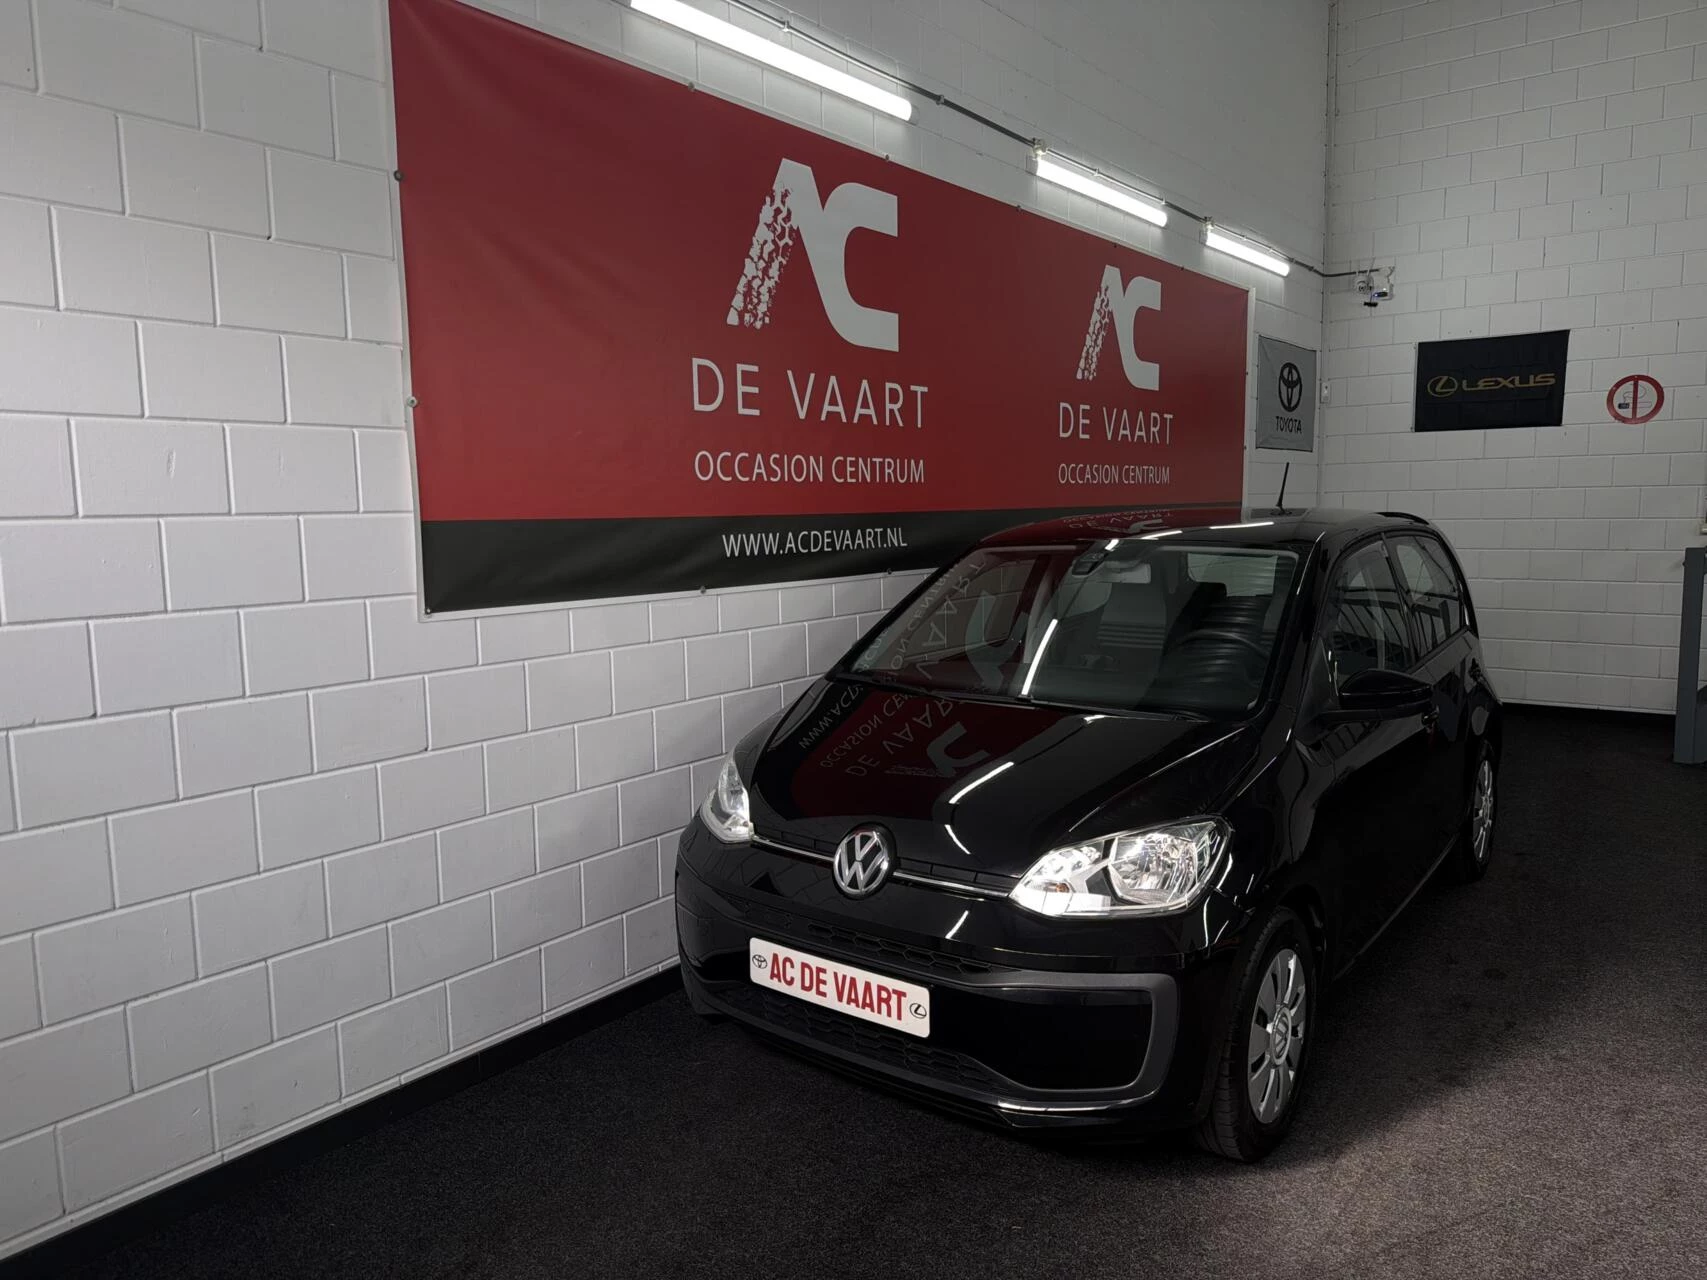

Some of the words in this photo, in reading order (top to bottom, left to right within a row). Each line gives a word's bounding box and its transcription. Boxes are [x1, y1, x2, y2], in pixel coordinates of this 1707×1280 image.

[691, 357, 761, 416] DE
[786, 370, 929, 428] VAART
[1461, 373, 1556, 391] LEXUS
[1059, 402, 1091, 440] DE
[1103, 405, 1173, 445] VAART
[1275, 416, 1302, 434] TOYOTA
[694, 450, 823, 483] OCCASION
[831, 456, 925, 484] CENTRUM
[1058, 463, 1119, 484] OCCASION
[1122, 465, 1170, 484] CENTRUM
[722, 528, 908, 558] WWW.ACDEVAART.NL
[769, 952, 795, 987] AC
[800, 961, 827, 998] DE
[833, 971, 907, 1021] VAART
